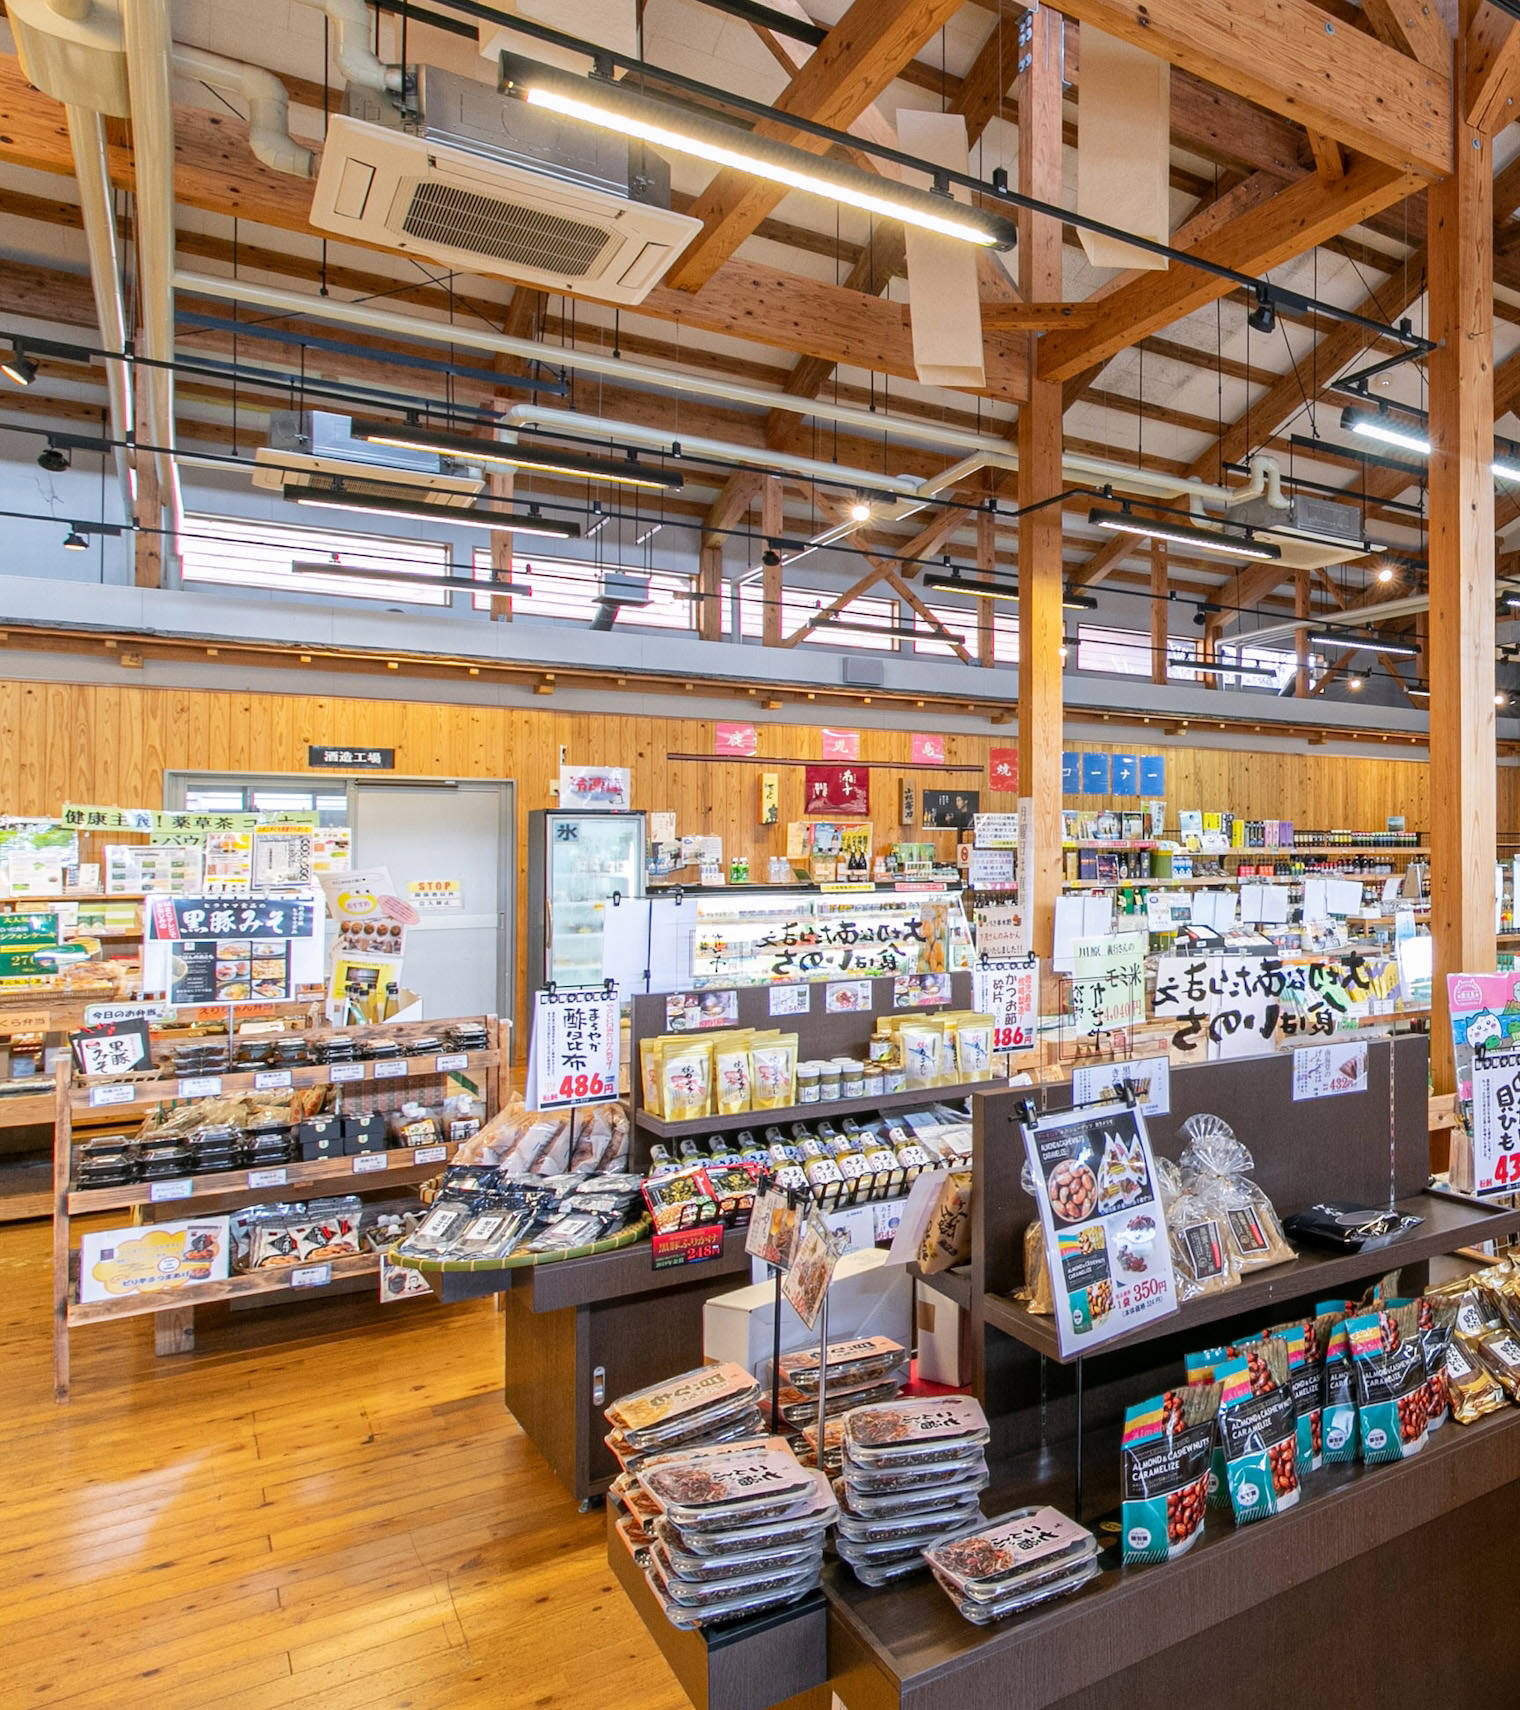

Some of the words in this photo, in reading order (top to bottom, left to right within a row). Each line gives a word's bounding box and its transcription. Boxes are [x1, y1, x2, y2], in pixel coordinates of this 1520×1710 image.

[324, 751, 382, 765] 酒造工場
[557, 824, 577, 840] 氷
[418, 882, 451, 891] STOP
[180, 909, 285, 934] 黒豚みそ
[1005, 973, 1018, 1026] かつお節
[561, 1007, 588, 1071] 酢昆布
[587, 1007, 602, 1053] まろやか
[109, 1040, 131, 1066] 黒豚
[1496, 1084, 1517, 1152] 貝ひも
[1232, 1417, 1273, 1440] CARAMELIZE
[1132, 1460, 1180, 1482] CARAMELIZE
